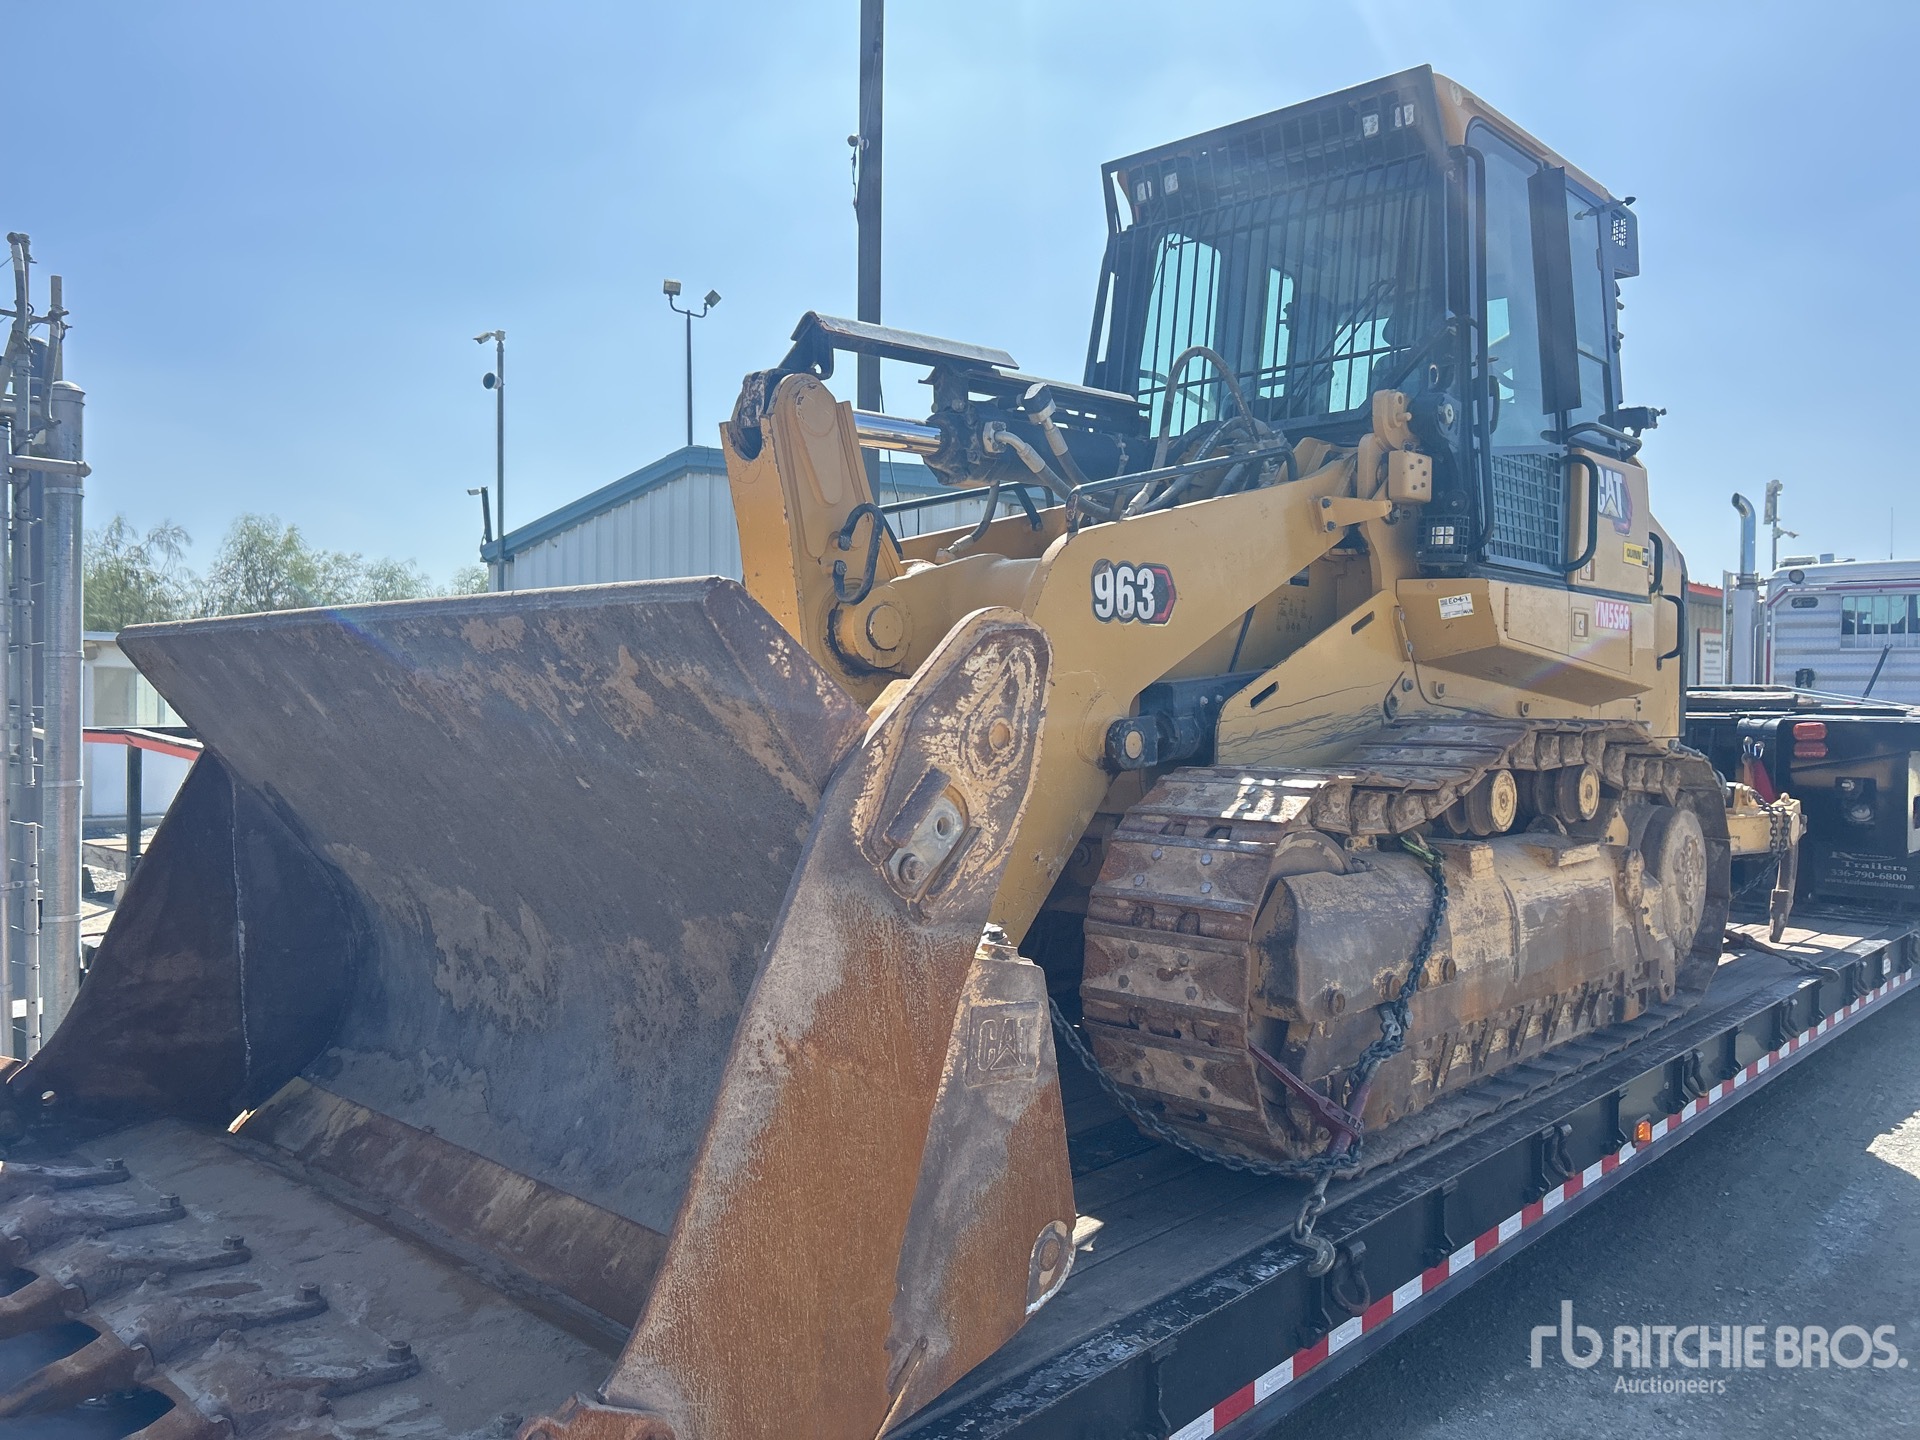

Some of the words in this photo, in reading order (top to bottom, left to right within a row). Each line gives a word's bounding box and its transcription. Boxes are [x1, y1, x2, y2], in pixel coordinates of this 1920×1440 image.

[1597, 465, 1623, 519] CAT
[1094, 565, 1155, 620] 963
[1831, 868, 1907, 882] 336-790-6800
[1841, 860, 1908, 872] Trailers
[978, 1018, 1034, 1071] CAT
